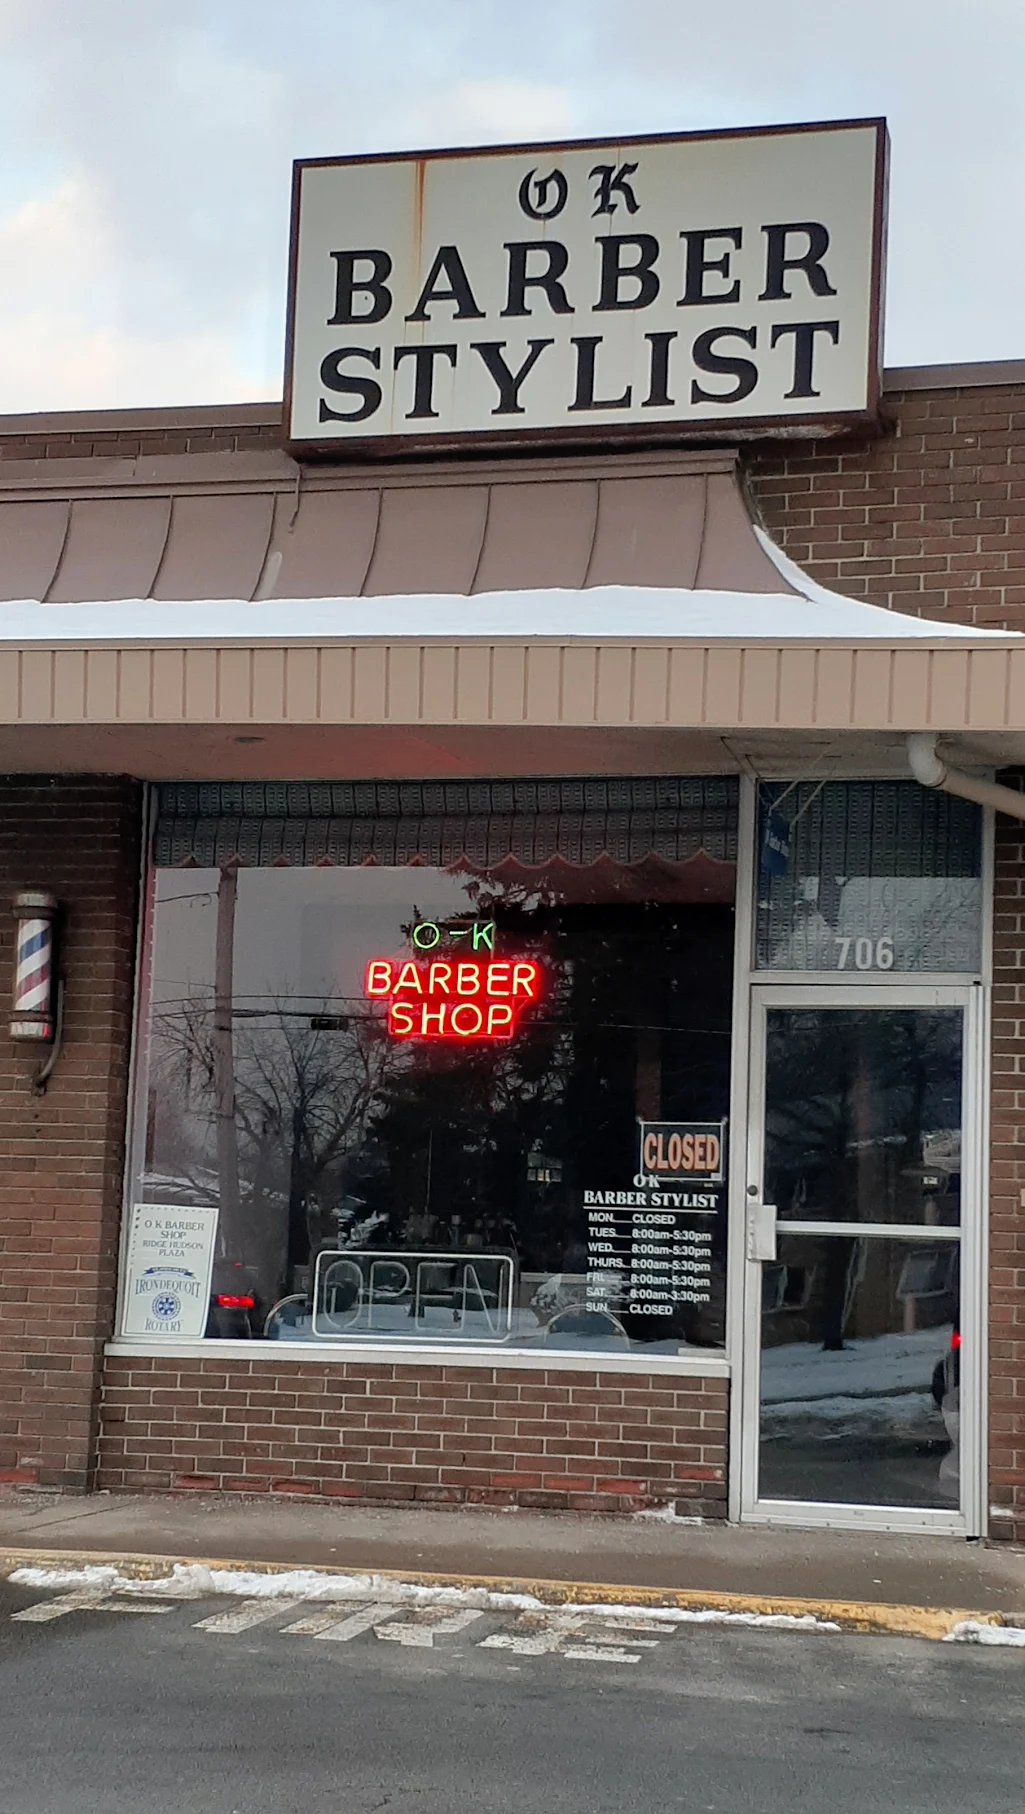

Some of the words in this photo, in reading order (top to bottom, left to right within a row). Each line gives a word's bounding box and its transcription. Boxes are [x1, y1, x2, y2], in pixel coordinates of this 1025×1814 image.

[518, 167, 569, 220] O
[587, 162, 640, 218] K
[326, 221, 838, 326] BARBER
[318, 321, 840, 424] STYLIST
[835, 936, 894, 970] 706
[368, 961, 536, 997] BARBER
[391, 1002, 512, 1036] SHOP
[643, 1132, 720, 1171] CLOSED
[633, 1173, 646, 1188] O
[649, 1174, 660, 1188] K
[584, 1190, 647, 1206] BARBER
[650, 1192, 719, 1208] STYLIST
[144, 1219, 152, 1229] O
[155, 1220, 162, 1229] K
[165, 1220, 204, 1231] BARBER
[632, 1213, 676, 1225] CLOSED
[160, 1230, 187, 1240] SHOP
[142, 1239, 167, 1248] RIDGE
[169, 1241, 204, 1250] HUDSON
[159, 1248, 185, 1257] PLAZA
[135, 1278, 201, 1299] IRONDEQUOIT
[629, 1303, 673, 1316] CLOSED
[144, 1317, 183, 1332] ROTARY
